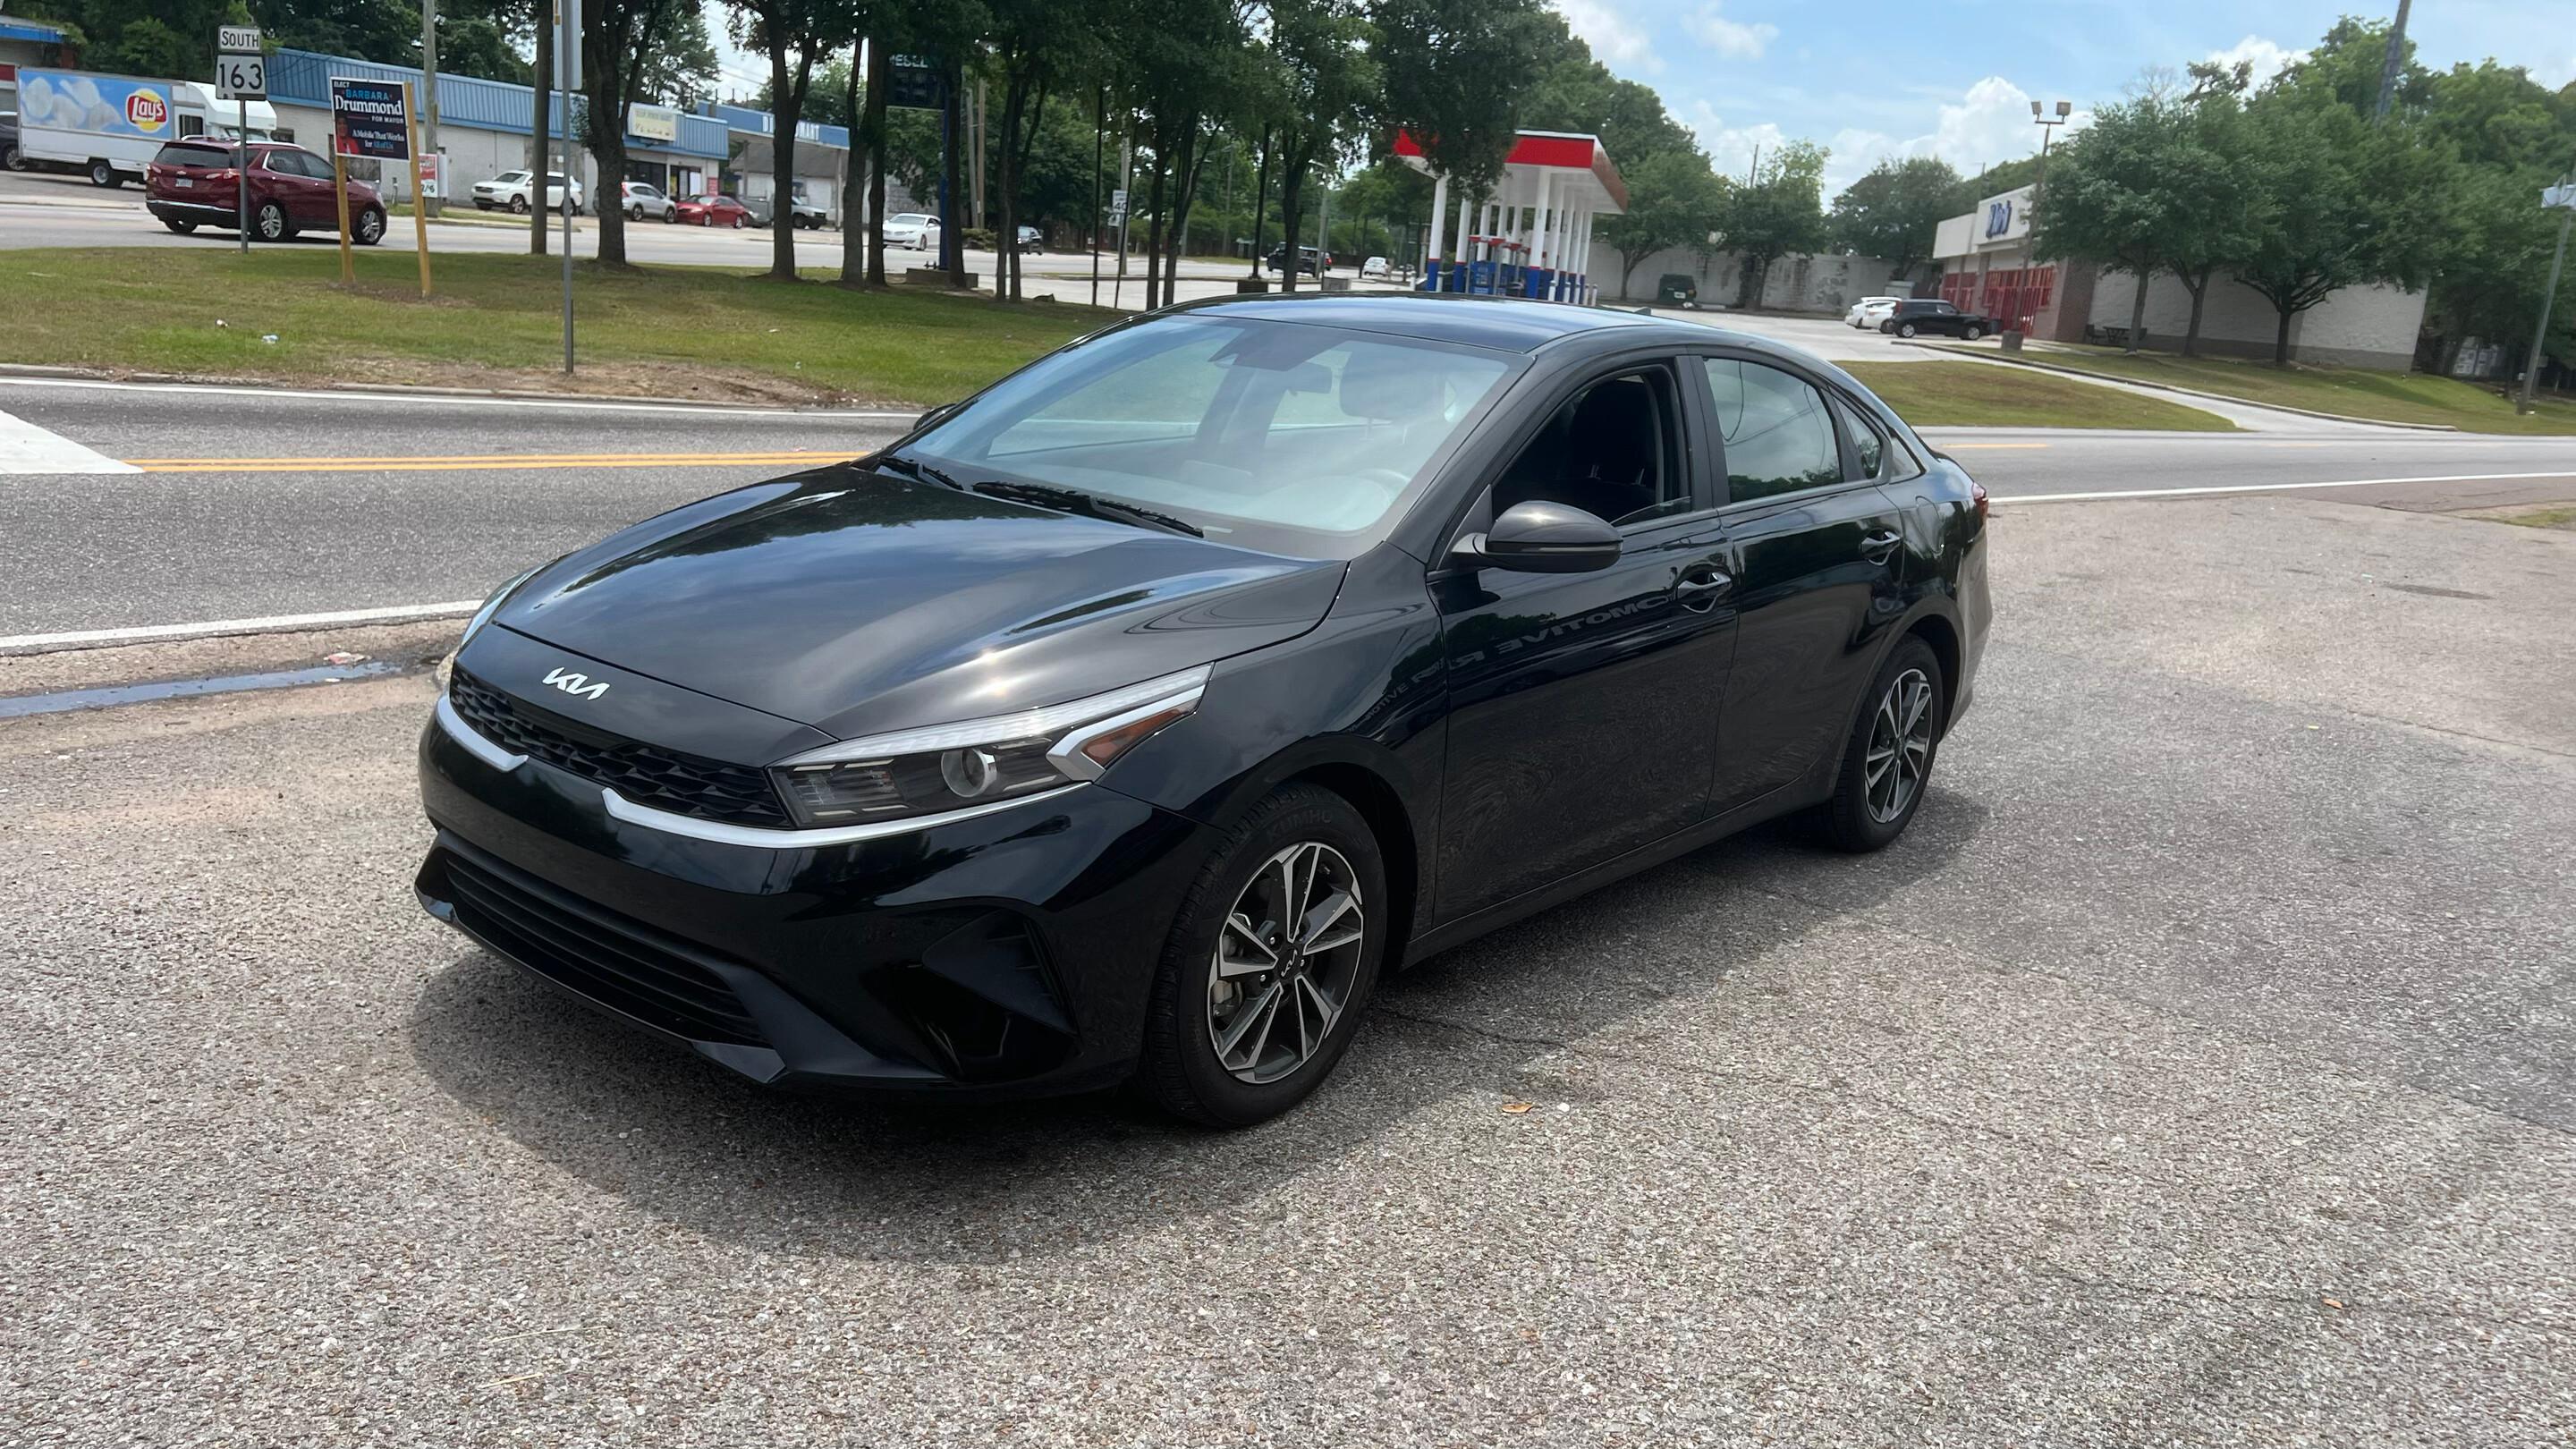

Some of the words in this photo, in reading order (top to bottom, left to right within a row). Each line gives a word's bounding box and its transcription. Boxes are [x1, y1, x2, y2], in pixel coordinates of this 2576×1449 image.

[221, 31, 258, 47] SOUTH
[219, 64, 262, 89] 163
[346, 89, 389, 100] BARBARA
[335, 95, 402, 115] Drummond
[542, 666, 610, 700] KIA
